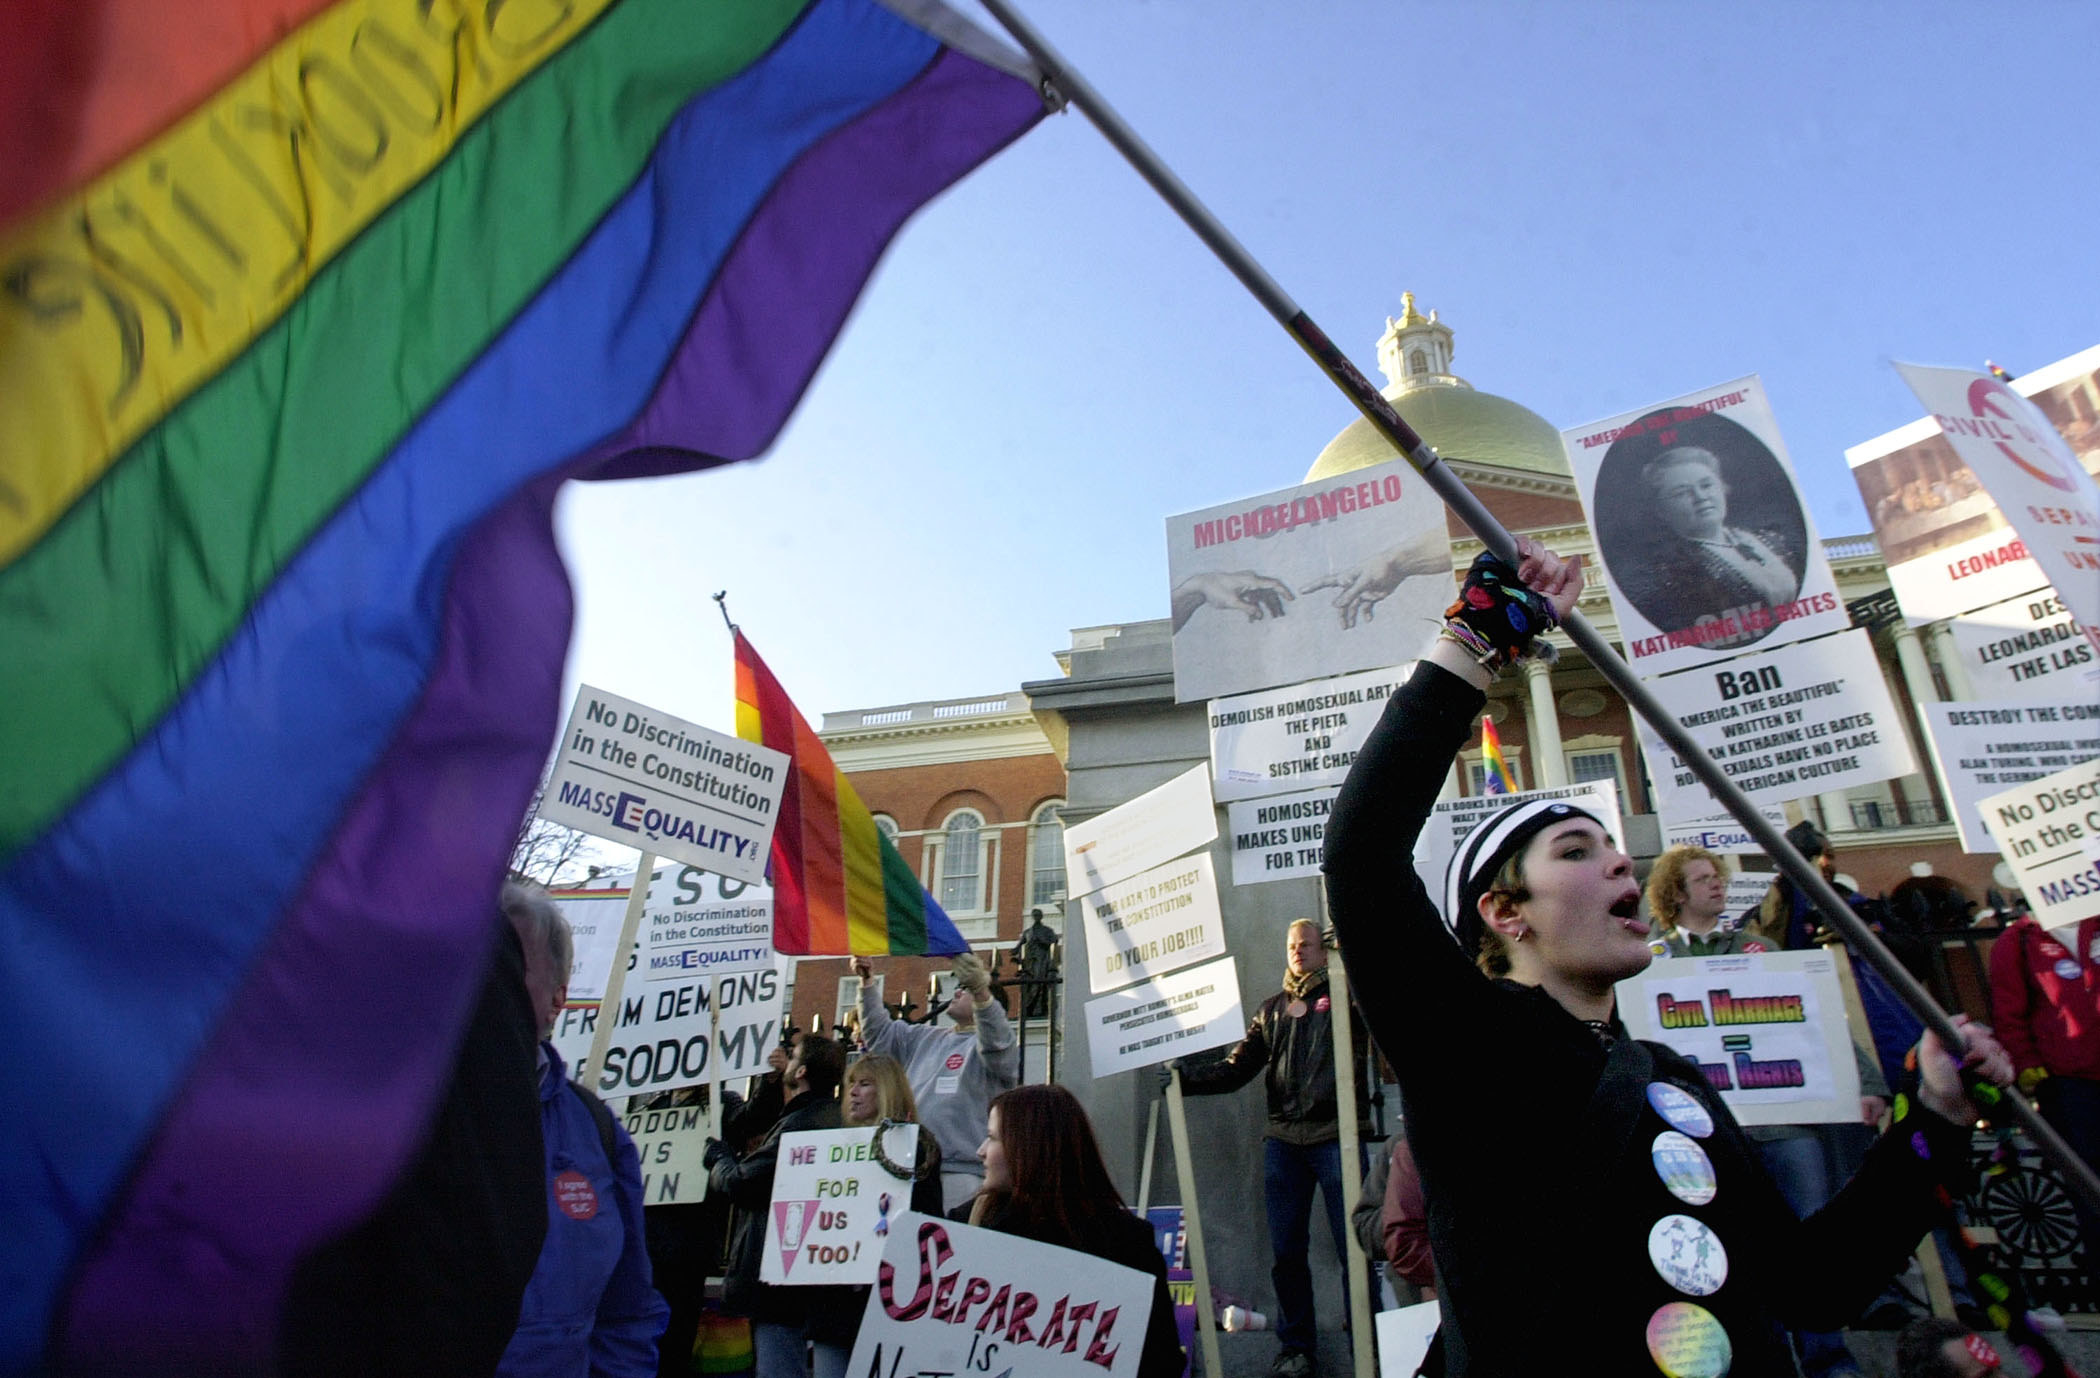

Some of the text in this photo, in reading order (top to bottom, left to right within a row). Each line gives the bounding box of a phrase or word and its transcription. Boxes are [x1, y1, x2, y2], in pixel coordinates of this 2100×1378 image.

[1193, 473, 1402, 550] MICHAELANGELO
[1774, 591, 1837, 623] BATES
[2009, 644, 2092, 682] THE LAS
[1714, 664, 1783, 701] Ban
[1211, 705, 1274, 729] DEMOLISH
[1277, 689, 1363, 715] HOMOSEXUAL
[1366, 683, 1392, 702] ART
[1740, 698, 1766, 715] THE
[1948, 708, 2023, 726] DESTROY
[2025, 706, 2059, 723] THE
[1285, 712, 1348, 736] THE PIETA
[1721, 708, 1805, 739] WRITTEN BY
[1728, 730, 1803, 757] KATHARINE
[1806, 722, 1829, 738] LEE
[1831, 712, 1875, 733] BATES
[586, 700, 774, 783] No Discrimination
[1304, 735, 1331, 752] AND
[571, 728, 772, 814] in the Constitution
[1268, 758, 1320, 778] SISTINE
[1675, 731, 1881, 788] HOEXUALS HAVE NO PLACE
[1734, 756, 1860, 794] MERICAN CULTURE
[1452, 800, 1486, 811] BOOKS
[1997, 803, 2034, 827] No
[1237, 822, 1326, 850] MAKES UNG
[2008, 836, 2037, 859] in
[2038, 822, 2085, 849] the
[1265, 850, 1294, 870] FOR
[1158, 870, 1200, 896] PROTECT
[2038, 860, 2100, 907] MASS
[650, 922, 769, 942] in the Constitution
[653, 907, 766, 926] No Discrimination
[1107, 917, 1124, 934] THE
[1106, 952, 1122, 974] DO
[1124, 940, 1159, 968] YOUR
[560, 968, 778, 1037] FRM DEMONS
[600, 1020, 775, 1091] SODOMY
[790, 1145, 817, 1166] HE
[816, 1178, 860, 1198] FOR
[819, 1210, 848, 1231] US
[807, 1240, 861, 1265] TOO!
[878, 1221, 1122, 1371] SEPARATE
[966, 1334, 999, 1372] IS
